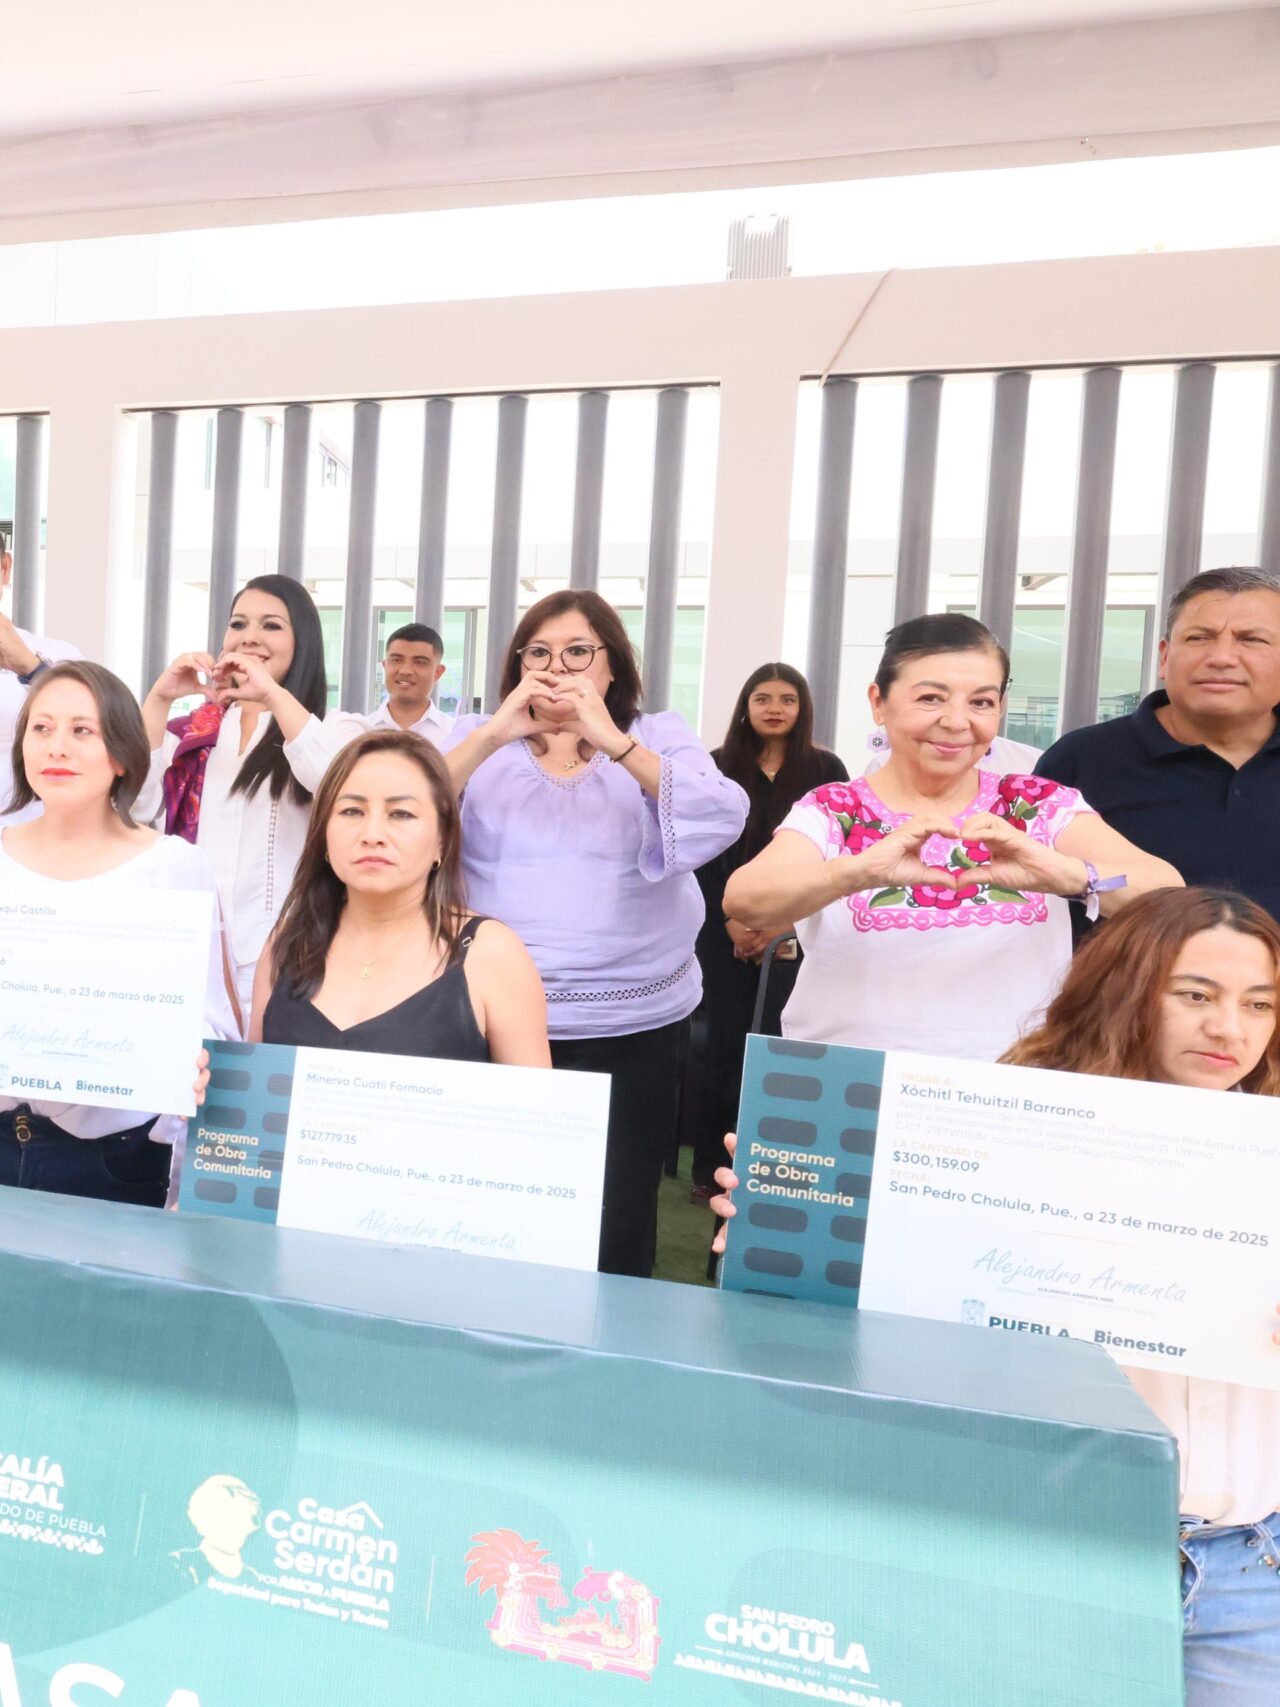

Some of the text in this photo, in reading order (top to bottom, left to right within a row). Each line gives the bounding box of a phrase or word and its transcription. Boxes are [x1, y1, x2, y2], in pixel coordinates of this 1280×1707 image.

[20, 905, 56, 916] Castillo
[1, 981, 40, 993] Cholula,
[43, 983, 66, 996] Pue.,
[70, 988, 76, 996] a
[79, 987, 90, 997] 23
[92, 988, 106, 998] de
[108, 991, 140, 1001] marzo
[143, 992, 156, 1003] de
[159, 994, 184, 1005] 2025
[11, 1075, 134, 1096] PUEBLA Bienestar
[307, 1072, 350, 1087] Minerva
[390, 1081, 443, 1096] Formacio
[900, 1071, 940, 1087] PAGAR
[900, 1083, 1096, 1120] Xóchitl Tehuitzil Barranco
[198, 1128, 259, 1146] Programa
[300, 1128, 357, 1145] $127,779.35
[892, 1137, 992, 1161] LA CANTIDAD DE:
[195, 1144, 247, 1159] de Obra
[750, 1142, 835, 1168] Programa
[892, 1149, 980, 1173] $300,159.09
[194, 1158, 271, 1179] Comunitaria
[297, 1154, 576, 1200] San Pedro Cholula, Pue., a 23 de marzo de 2025
[748, 1162, 819, 1183] de Obra
[889, 1168, 931, 1184] FECHA:
[747, 1179, 854, 1207] Comunitaria
[889, 1180, 1269, 1248] San Pedro Cholula, Pue., a 23 de marzo de 2025
[356, 1208, 518, 1251] Alejandro Armenta
[973, 1247, 1081, 1285] Alejandro
[1089, 1264, 1187, 1304] Armenta
[1094, 1329, 1187, 1357] Bienestar
[25, 1508, 45, 1524] DE
[49, 1513, 107, 1538] PUEBLA
[298, 1497, 366, 1531] Casa
[265, 1510, 398, 1564] Carmen
[273, 1539, 395, 1593] Serdán
[741, 1604, 835, 1636] SAN PEDRO
[704, 1613, 871, 1674] CHOLULA
